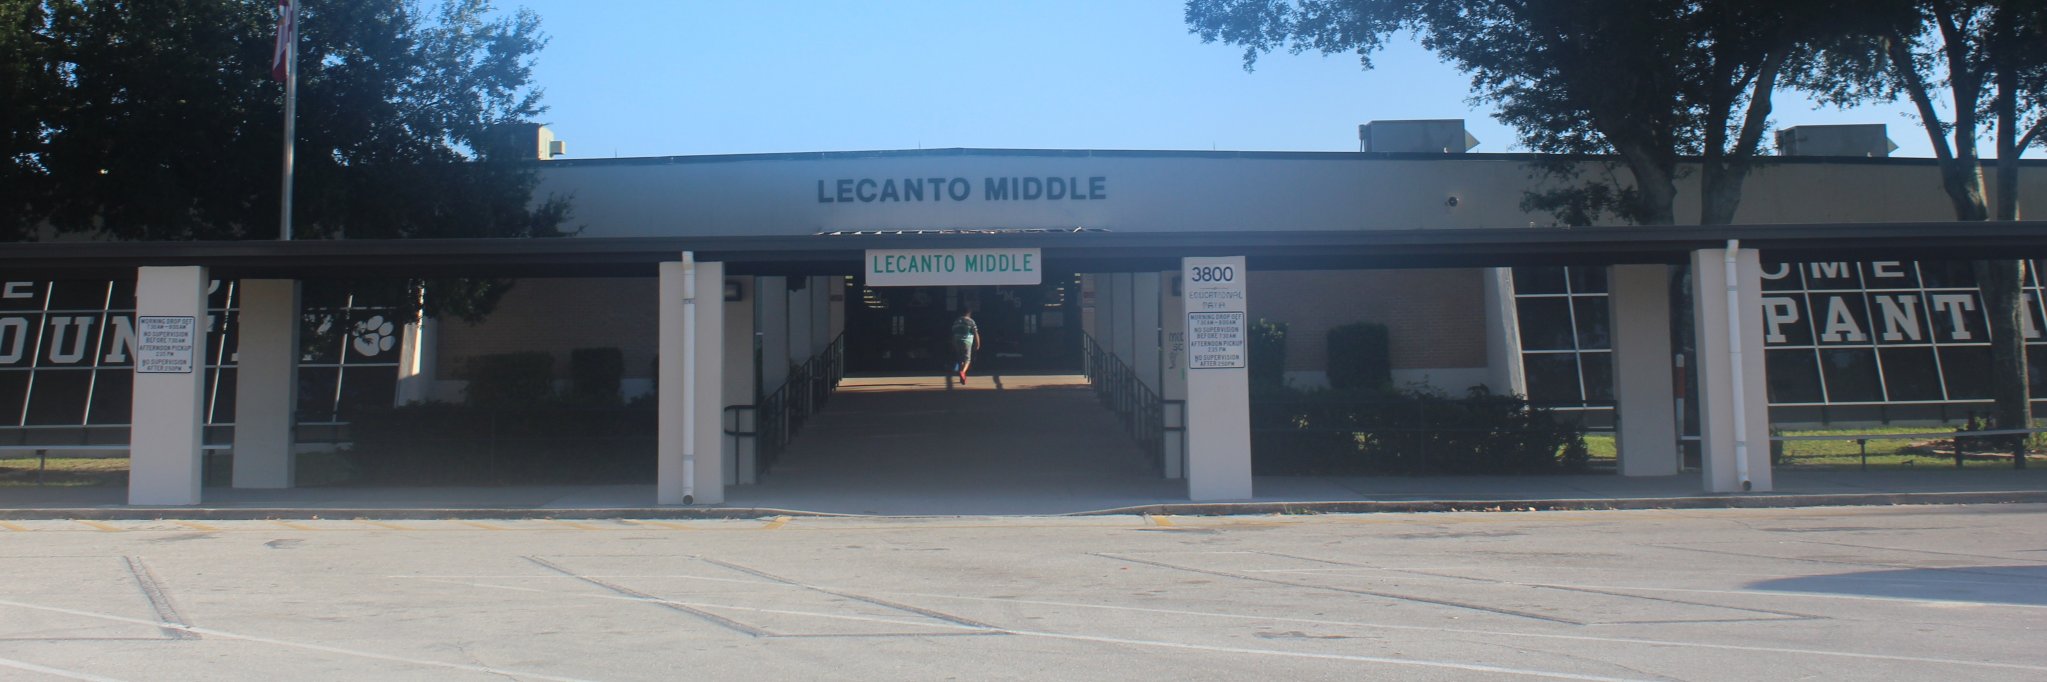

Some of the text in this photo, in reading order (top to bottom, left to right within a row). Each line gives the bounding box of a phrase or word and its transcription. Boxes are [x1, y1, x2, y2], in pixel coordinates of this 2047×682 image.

[817, 176, 1107, 203] LECANTO MIDDLE
[873, 253, 1033, 273] LECANTO MIDDLE
[1191, 266, 1234, 282] 3800
